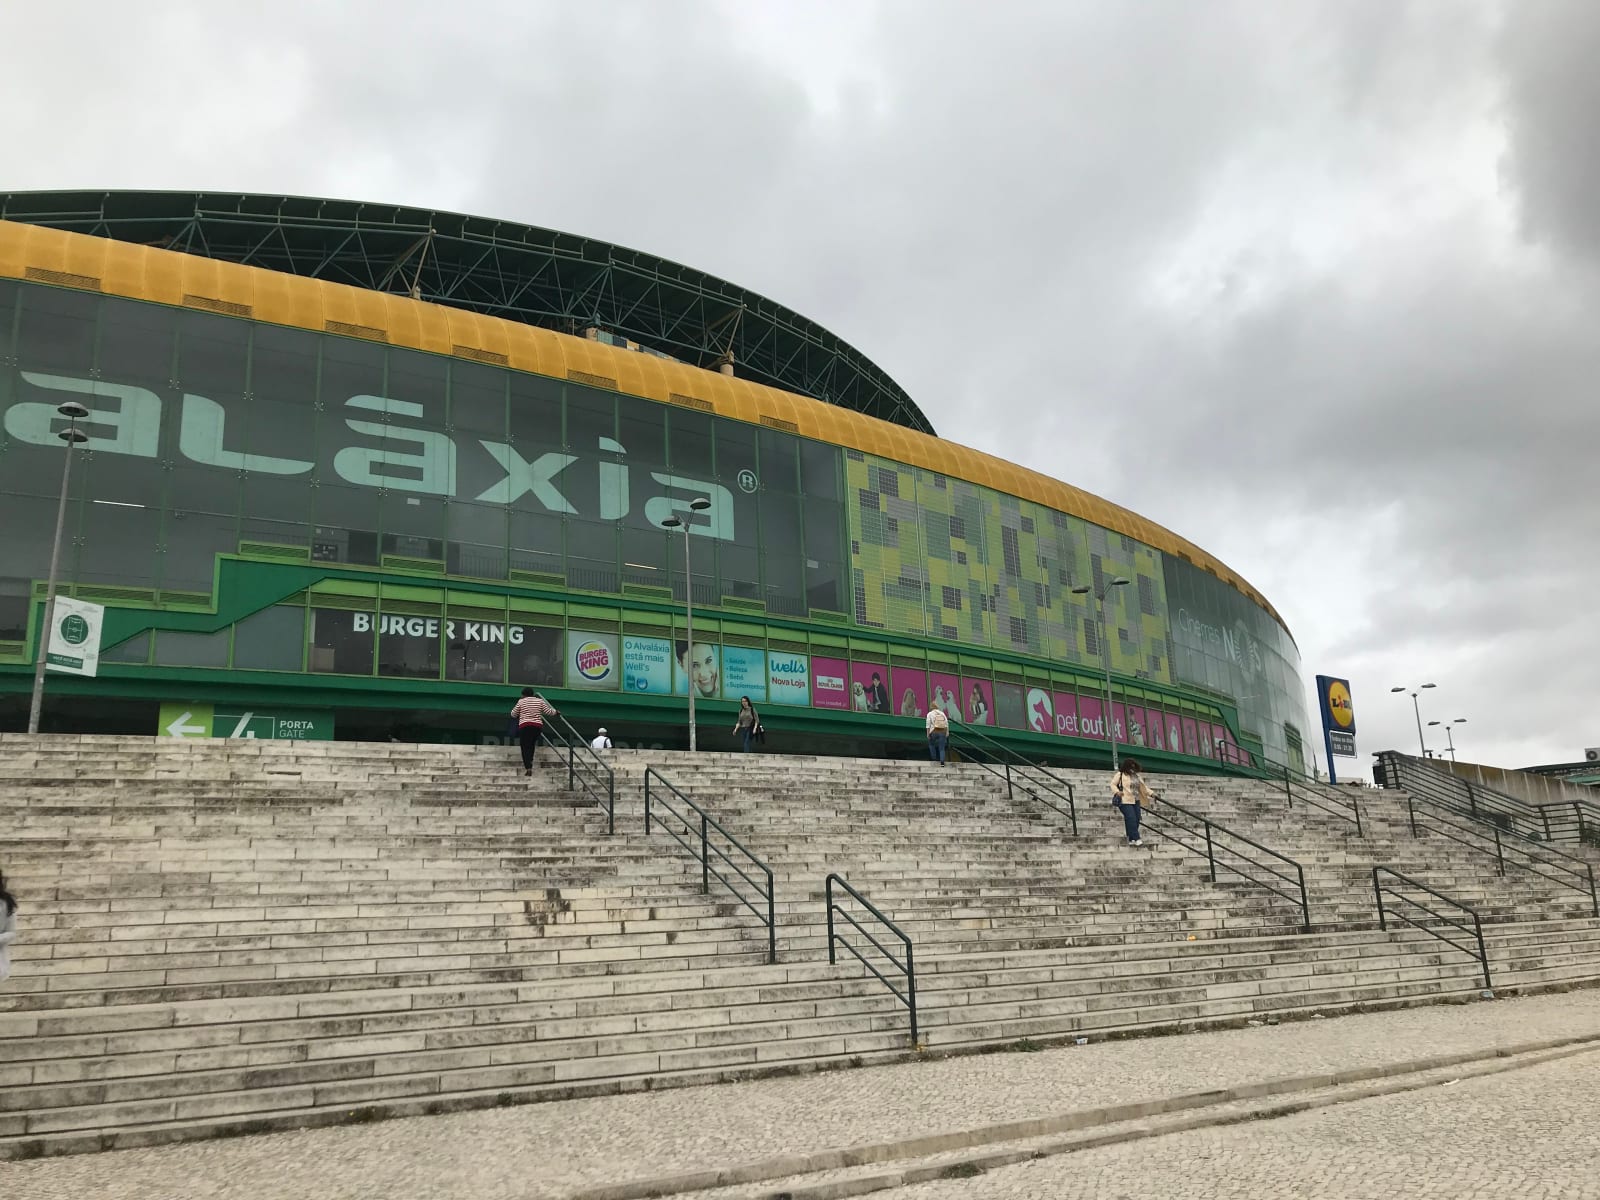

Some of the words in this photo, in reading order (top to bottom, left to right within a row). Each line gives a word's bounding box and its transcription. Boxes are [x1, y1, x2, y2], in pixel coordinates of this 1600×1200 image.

[353, 613, 456, 640] BURGER
[465, 622, 524, 644] KING
[634, 642, 670, 653] Alvaláxia
[579, 648, 608, 662] BURGER
[625, 651, 644, 660] está
[644, 654, 664, 663] mais
[580, 656, 609, 671] KING
[625, 662, 650, 672] Well's
[772, 677, 790, 686] Nova
[791, 679, 805, 689] Loja
[280, 720, 314, 730] PORTA
[279, 729, 305, 739] GATE
